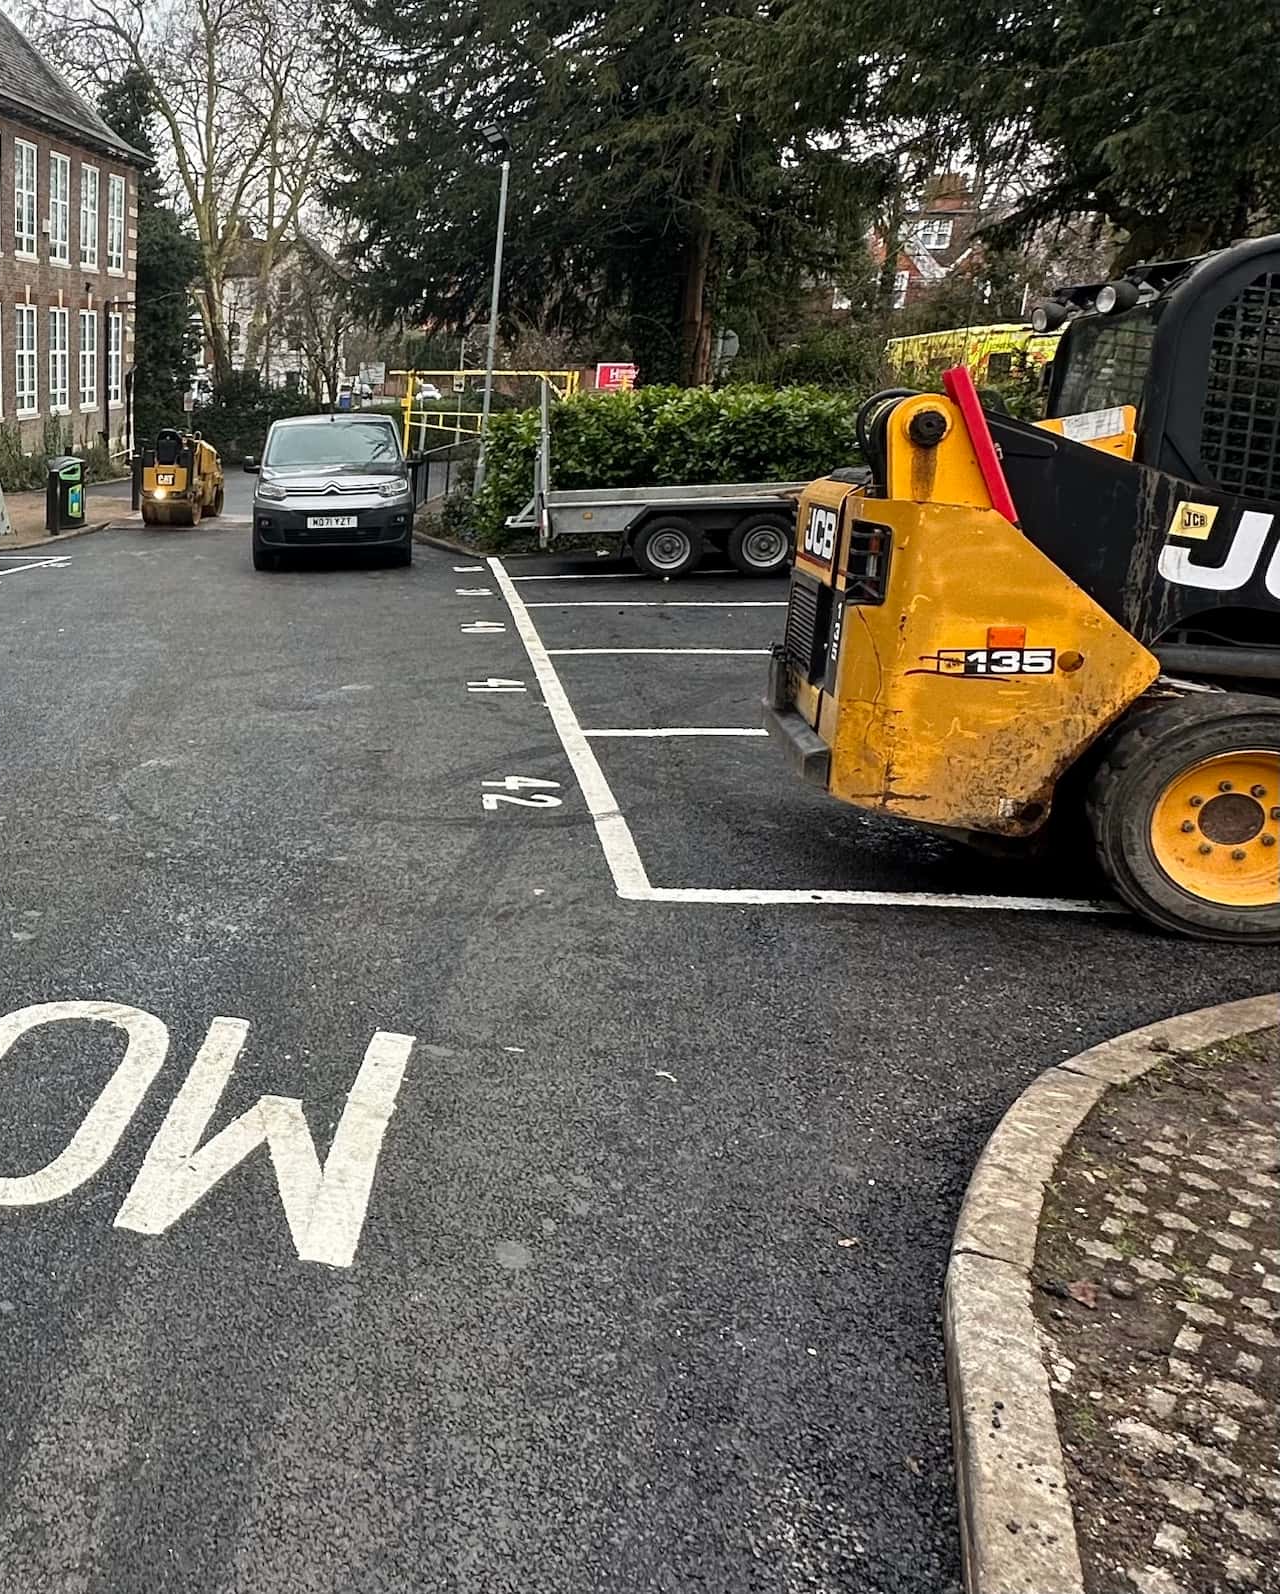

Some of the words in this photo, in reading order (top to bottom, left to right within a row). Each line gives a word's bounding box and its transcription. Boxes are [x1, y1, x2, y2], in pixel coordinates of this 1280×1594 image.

[157, 474, 174, 485] CAT
[1184, 511, 1206, 527] JCB
[805, 507, 837, 561] JCB
[1157, 510, 1280, 600] J
[966, 650, 1052, 673] 135
[466, 678, 528, 692] 41
[481, 775, 563, 810] 42
